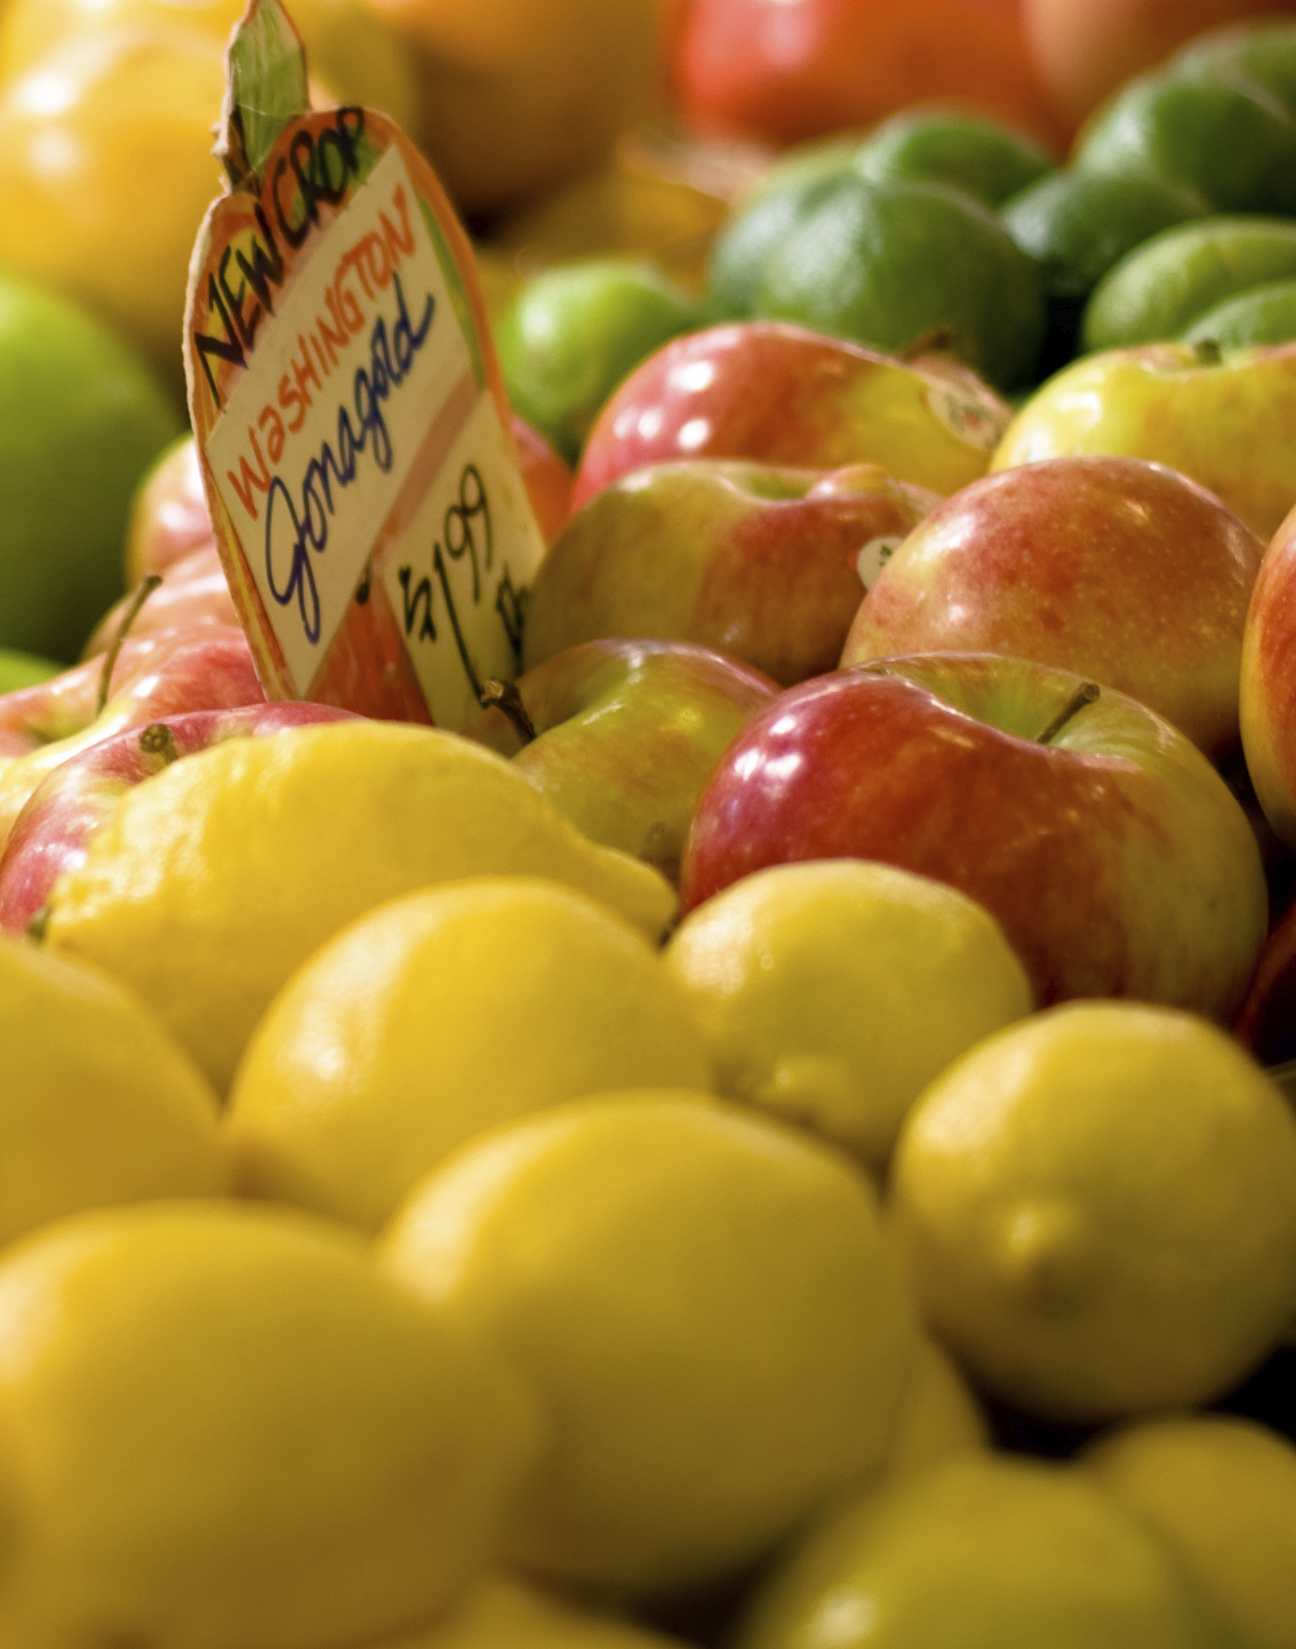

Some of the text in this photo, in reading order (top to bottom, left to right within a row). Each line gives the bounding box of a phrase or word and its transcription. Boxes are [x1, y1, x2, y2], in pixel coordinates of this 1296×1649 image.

[194, 105, 364, 410] NEW CROP
[266, 269, 435, 645] Jonagold
